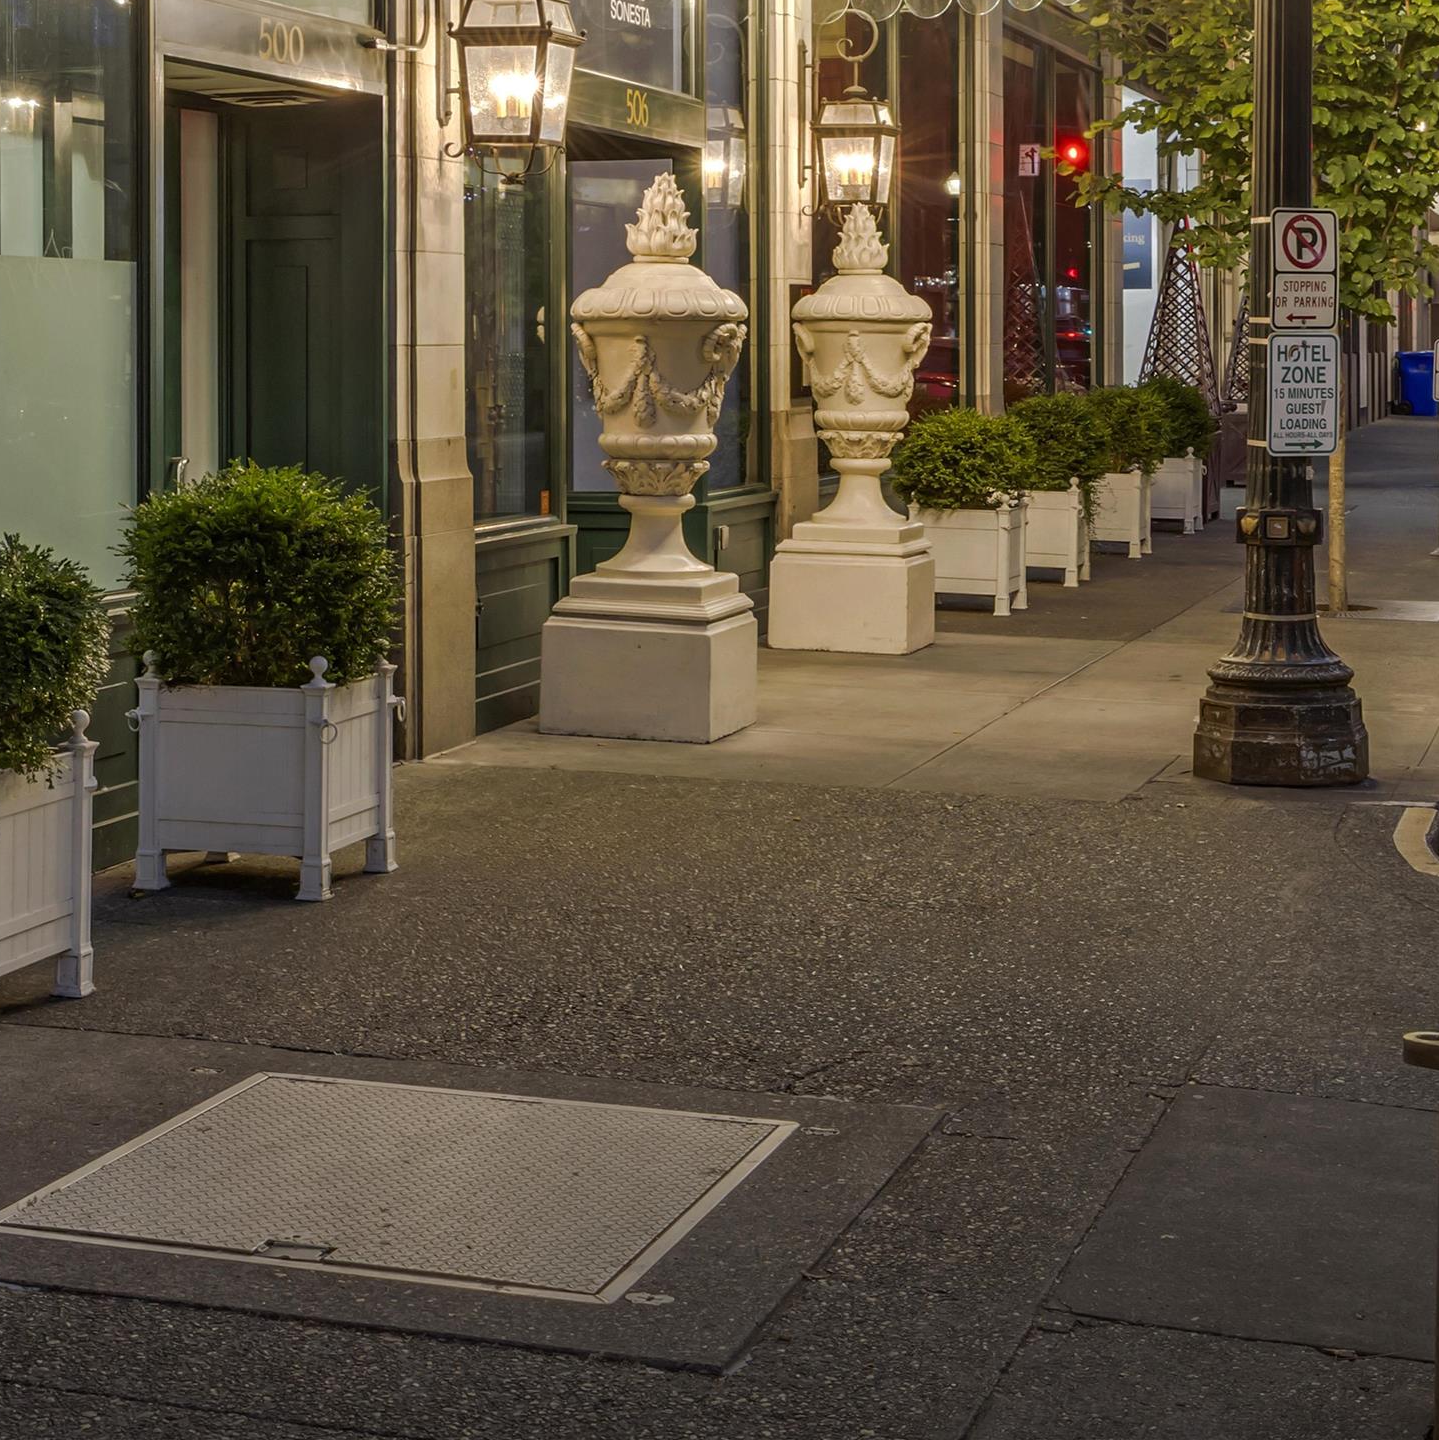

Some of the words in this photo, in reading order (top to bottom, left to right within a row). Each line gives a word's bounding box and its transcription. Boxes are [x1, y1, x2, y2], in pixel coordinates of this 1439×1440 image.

[258, 16, 304, 65] 500
[626, 87, 649, 128] 506
[1282, 280, 1328, 293] STOPPING
[1275, 296, 1288, 308] OR
[1293, 296, 1334, 308] PARKING
[1276, 344, 1332, 363] HOTEL
[1280, 365, 1327, 384] ZONE
[1273, 387, 1286, 399] 15
[1287, 387, 1335, 399] MINUTES
[1279, 418, 1328, 430] LOADING
